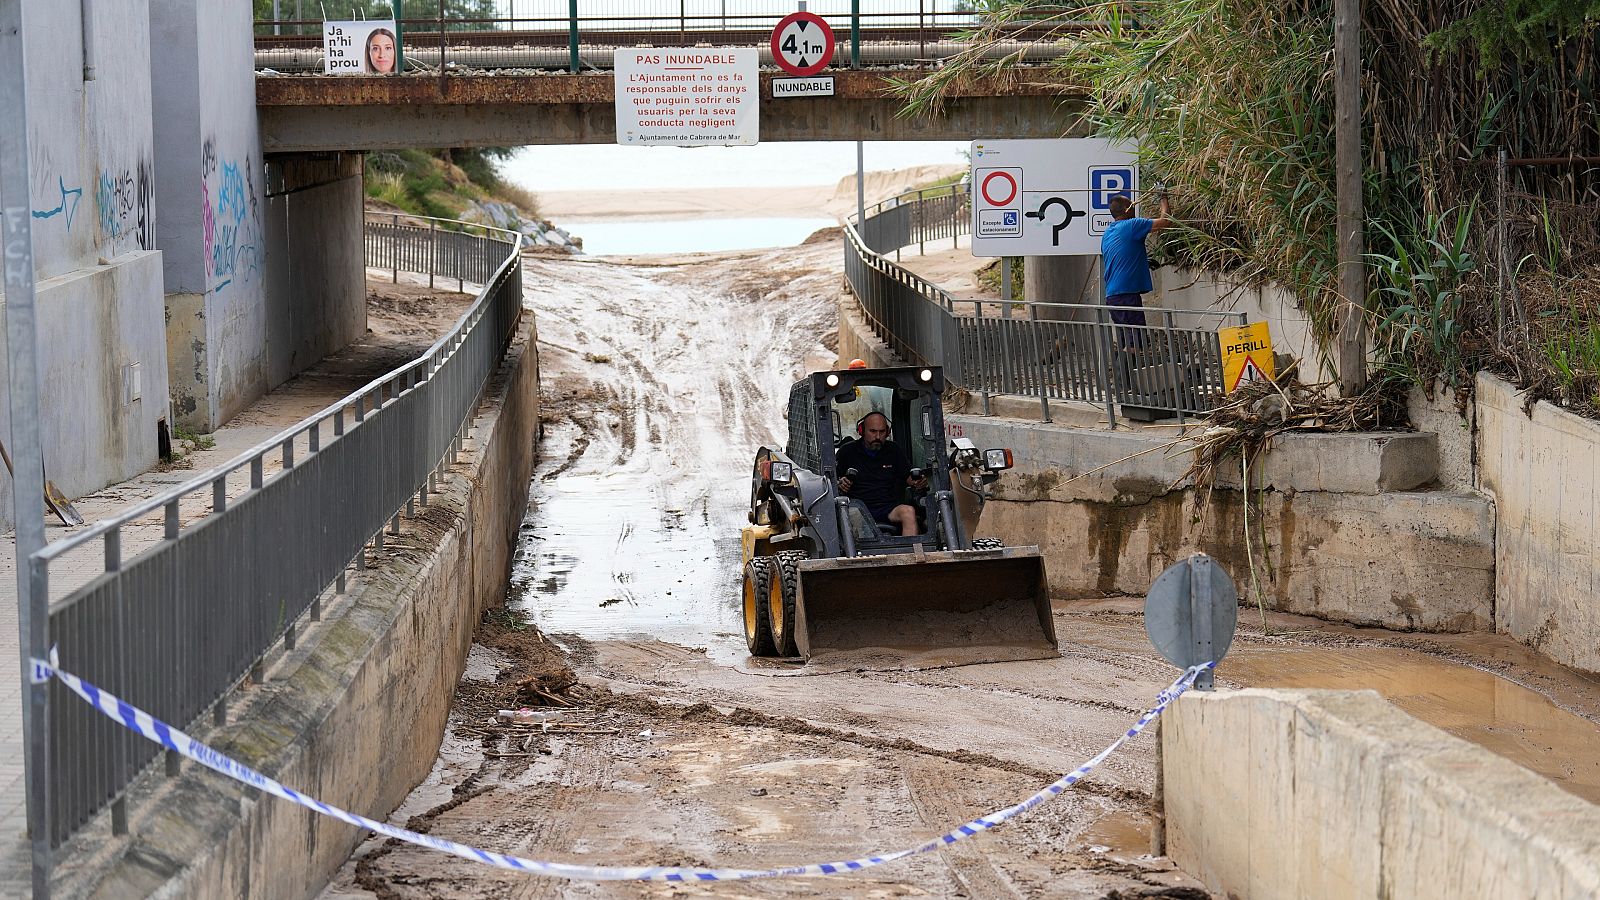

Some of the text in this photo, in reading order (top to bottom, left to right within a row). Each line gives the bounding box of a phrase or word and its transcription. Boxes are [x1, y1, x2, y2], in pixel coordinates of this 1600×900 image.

[328, 26, 342, 35] Ja
[330, 47, 344, 57] ha
[636, 54, 736, 64] PAS INUNDABLE
[330, 59, 359, 70] prou
[630, 73, 696, 83] L'Ajuntament
[733, 73, 743, 81] fa
[626, 85, 747, 94] responsable dels danys
[775, 82, 832, 92] INUNDABLE
[633, 96, 741, 105] que puguin sofrir els
[679, 108, 695, 116] per
[639, 119, 736, 128] conducta negligent
[1100, 174, 1125, 205] P
[1227, 340, 1267, 355] PERILL
